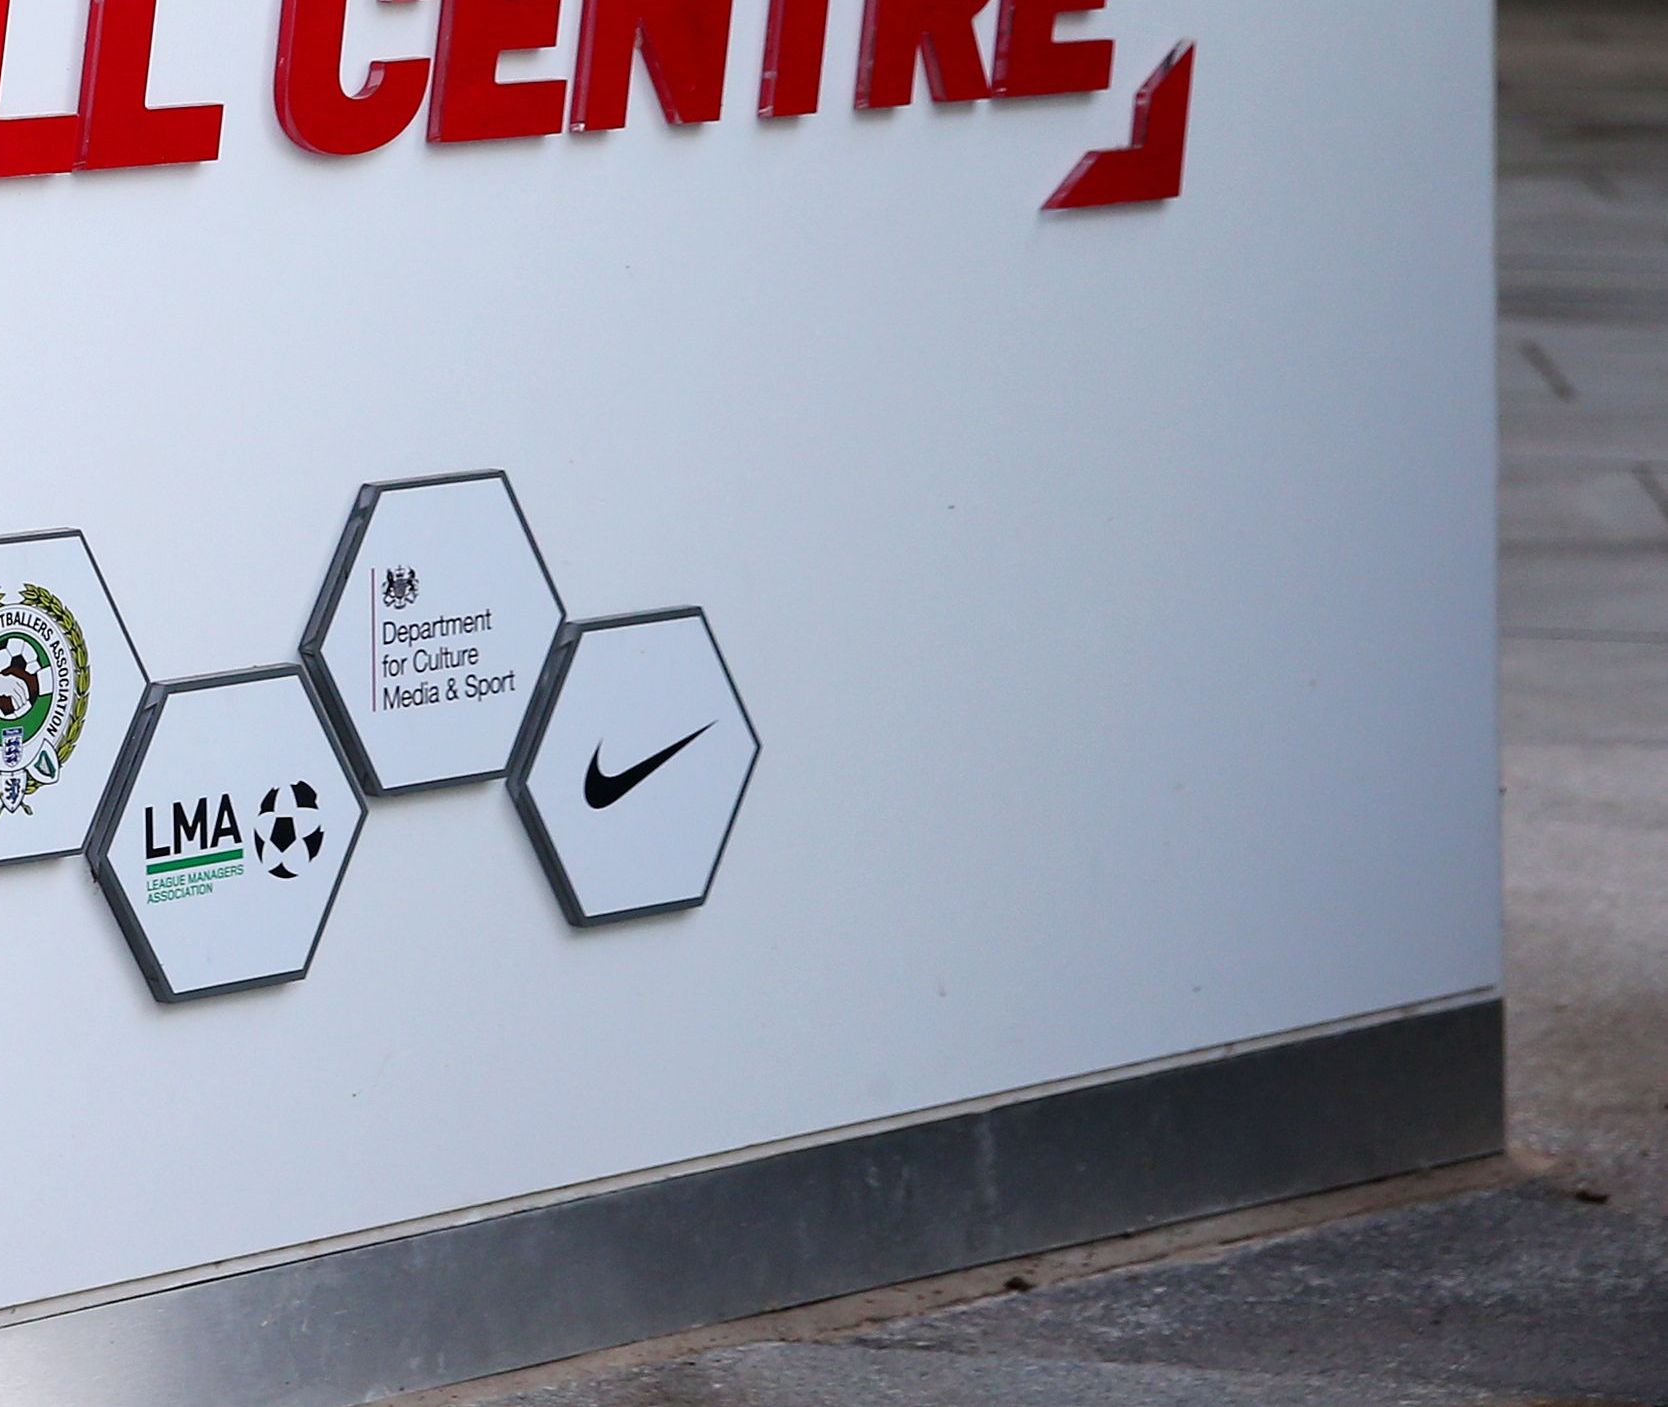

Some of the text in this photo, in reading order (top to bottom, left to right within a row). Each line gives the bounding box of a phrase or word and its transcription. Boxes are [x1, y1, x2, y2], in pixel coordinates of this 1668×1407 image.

[382, 609, 492, 647] Department
[382, 647, 479, 678] for Culture
[46, 640, 70, 738] ASSOCIATION
[383, 670, 516, 710] Media & Sport
[145, 793, 243, 859] LMA
[146, 864, 245, 892] LEAGUE MANAGERS
[146, 882, 214, 905] ASSOCIATION
